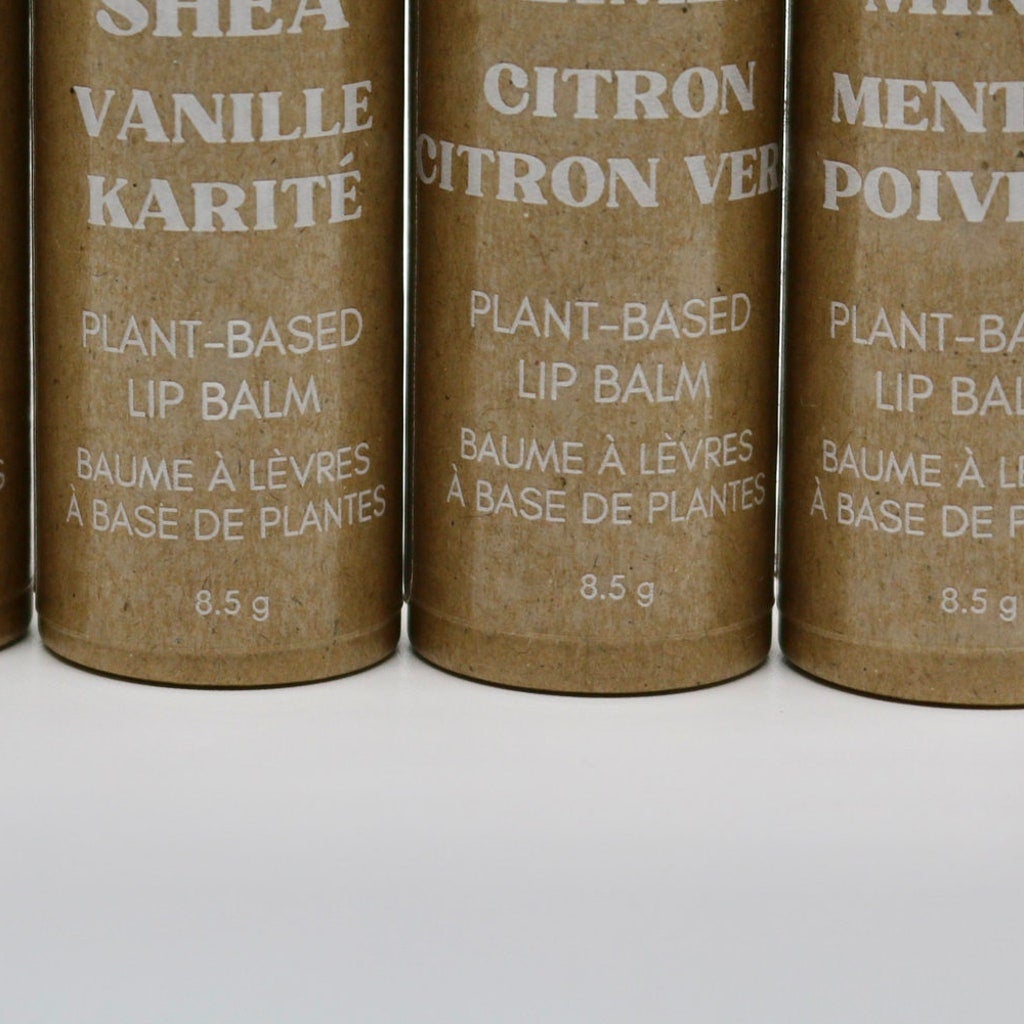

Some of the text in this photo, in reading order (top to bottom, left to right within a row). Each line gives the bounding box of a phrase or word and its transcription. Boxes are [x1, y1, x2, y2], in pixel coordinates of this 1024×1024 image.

[73, 80, 372, 143] VANILLE
[484, 61, 756, 119] CITRON
[87, 152, 362, 233] KARITÉ
[417, 134, 779, 208] CITRON VER
[82, 308, 364, 359] PLANT-BASED
[470, 290, 751, 341] PLANT-BASED
[129, 376, 321, 420] LIP BALM
[518, 359, 711, 403] LIP BALM
[875, 371, 935, 412] LIP
[77, 442, 370, 492] BAUME À LÈVRES
[461, 427, 753, 475] BAUME À LÈVRES
[823, 439, 941, 487] BAUME
[956, 446, 986, 488] À
[66, 484, 386, 541] À BASE DE PLANTES
[447, 464, 765, 525] À BASE DE PLANTES
[810, 476, 828, 520] À
[837, 494, 925, 536] BASE
[941, 505, 993, 538] DE
[195, 590, 269, 621] 8.5 g
[580, 574, 655, 607] 8.5 g
[941, 587, 1017, 621] 8.5 g
